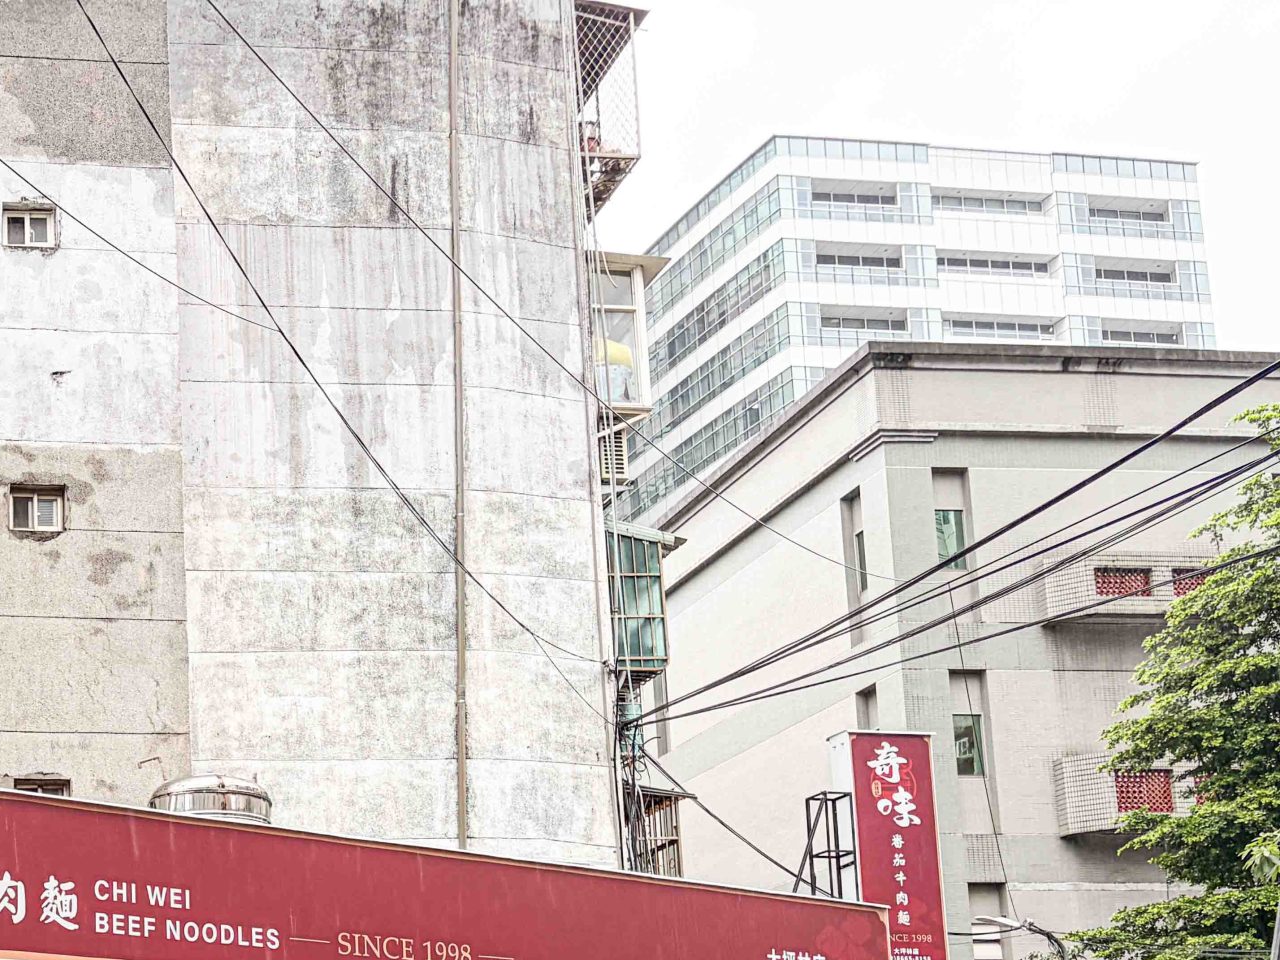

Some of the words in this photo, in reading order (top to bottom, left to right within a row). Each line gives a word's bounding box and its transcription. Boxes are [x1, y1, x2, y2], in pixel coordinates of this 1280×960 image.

[867, 741, 921, 827] 奇味
[95, 880, 136, 904] CHI
[147, 885, 190, 910] WEI
[891, 834, 911, 926] 番茄牛肉麵
[95, 913, 156, 938] BEEF
[166, 919, 280, 950] NOODLES
[337, 932, 415, 960] SINCE
[890, 933, 909, 942] NCE
[912, 934, 932, 943] 1998
